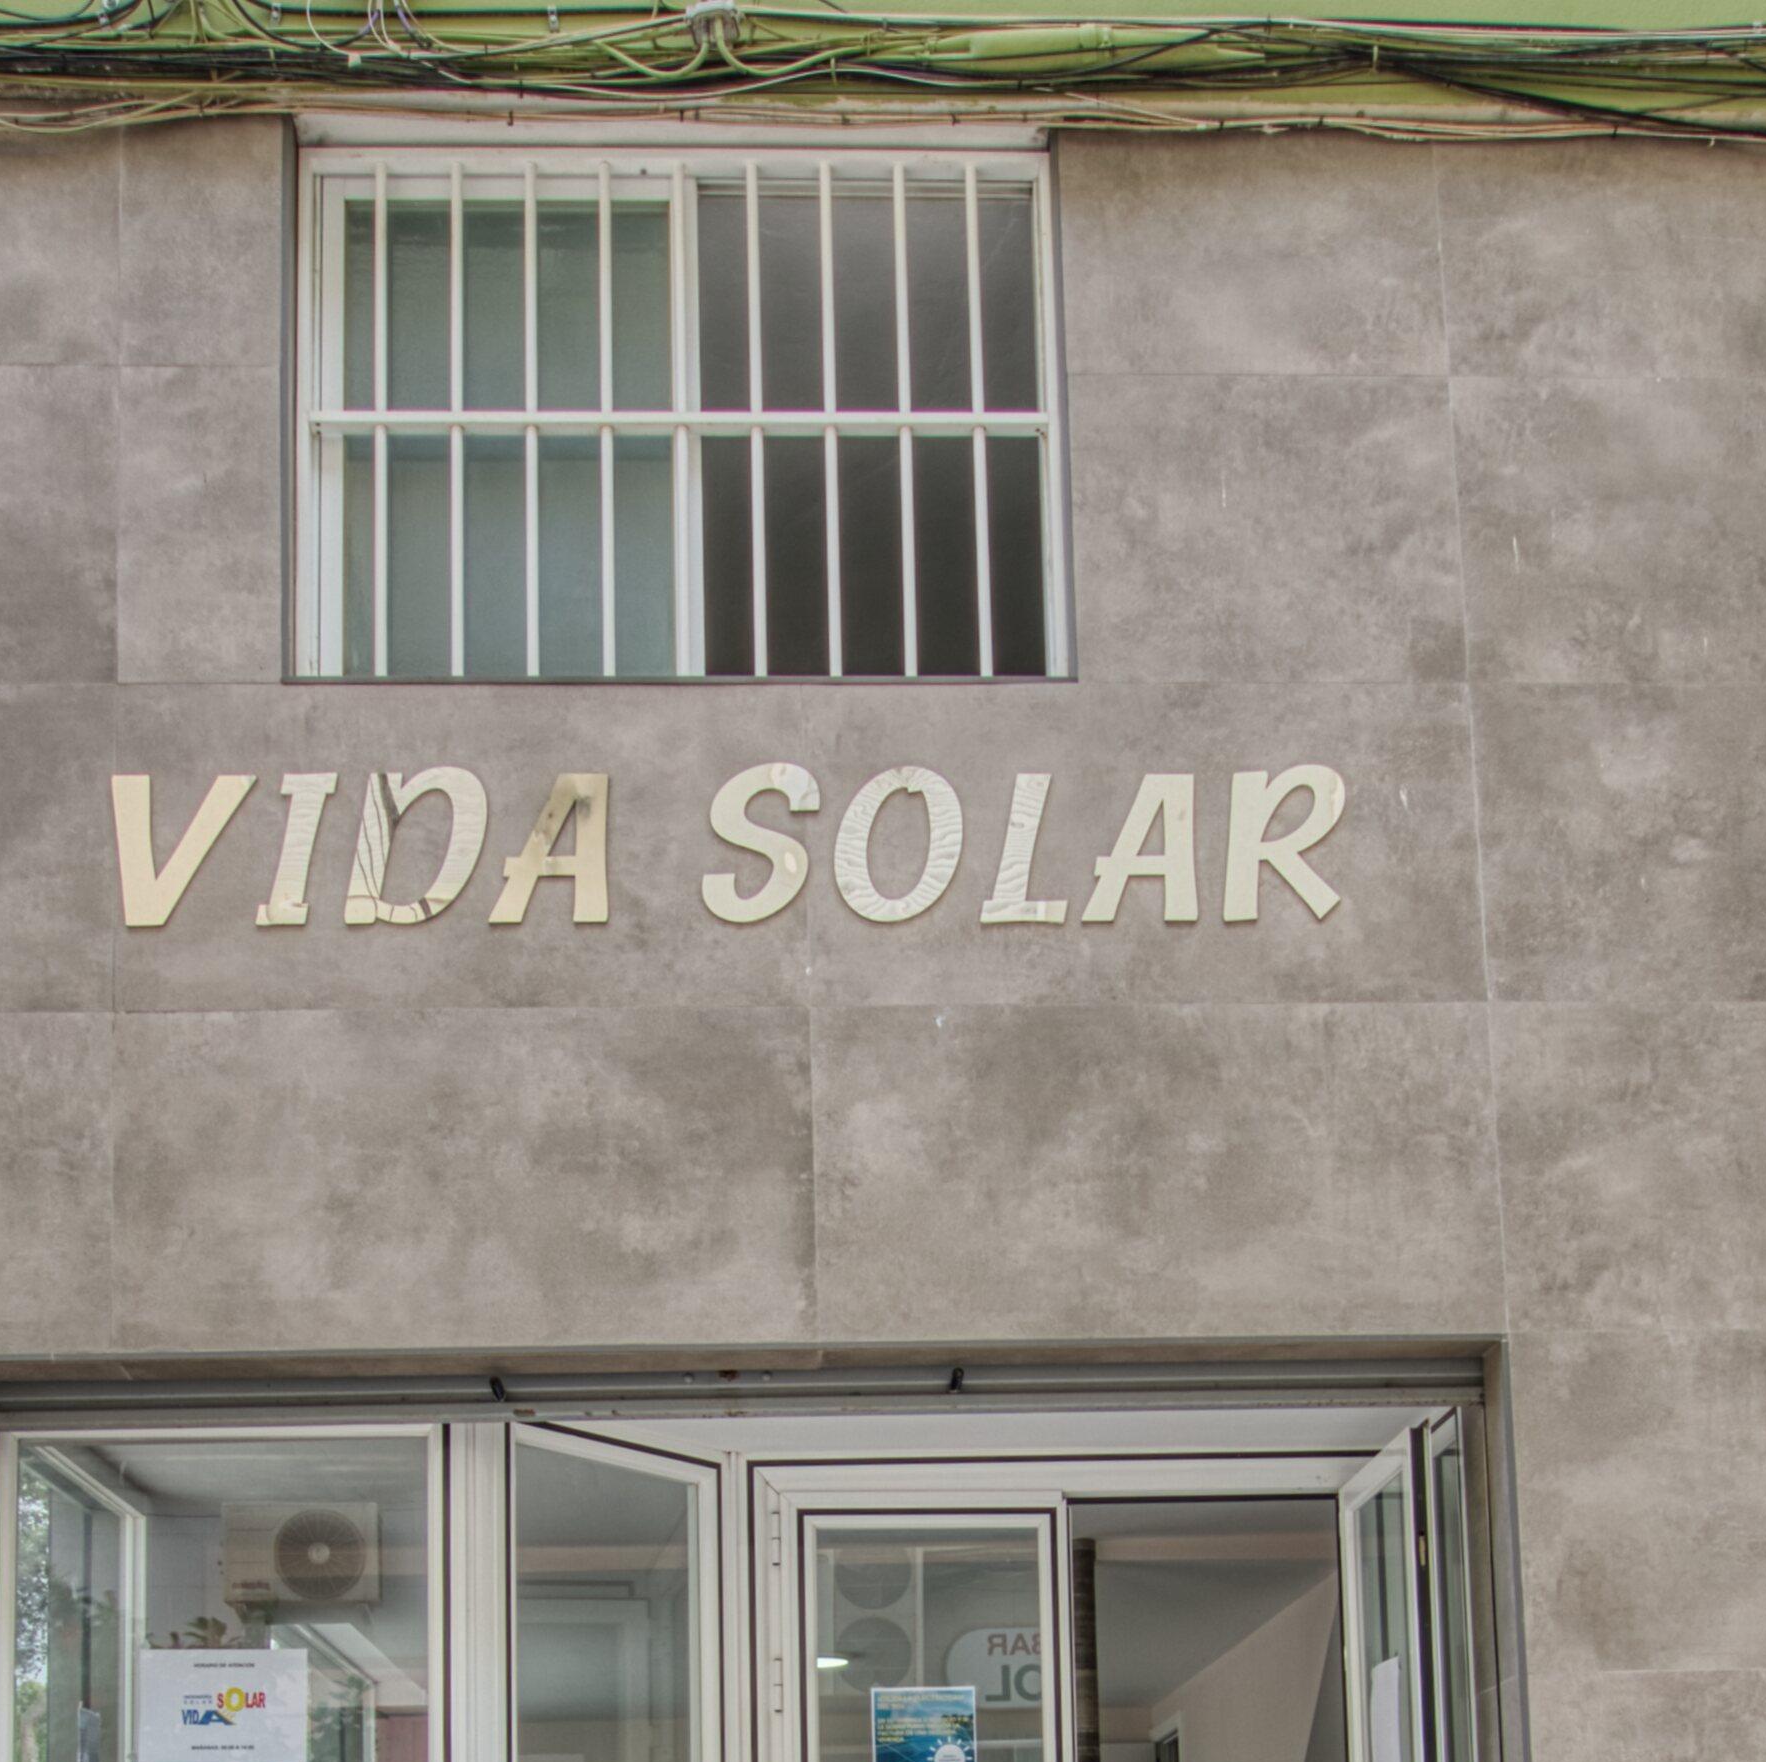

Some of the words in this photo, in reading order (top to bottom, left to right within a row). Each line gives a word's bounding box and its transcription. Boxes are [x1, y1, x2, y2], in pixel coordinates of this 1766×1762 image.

[110, 765, 610, 928] VIDA
[701, 761, 1347, 924] SOLAR
[216, 1687, 267, 1713] SOLAR
[181, 1709, 236, 1726] VIDA
